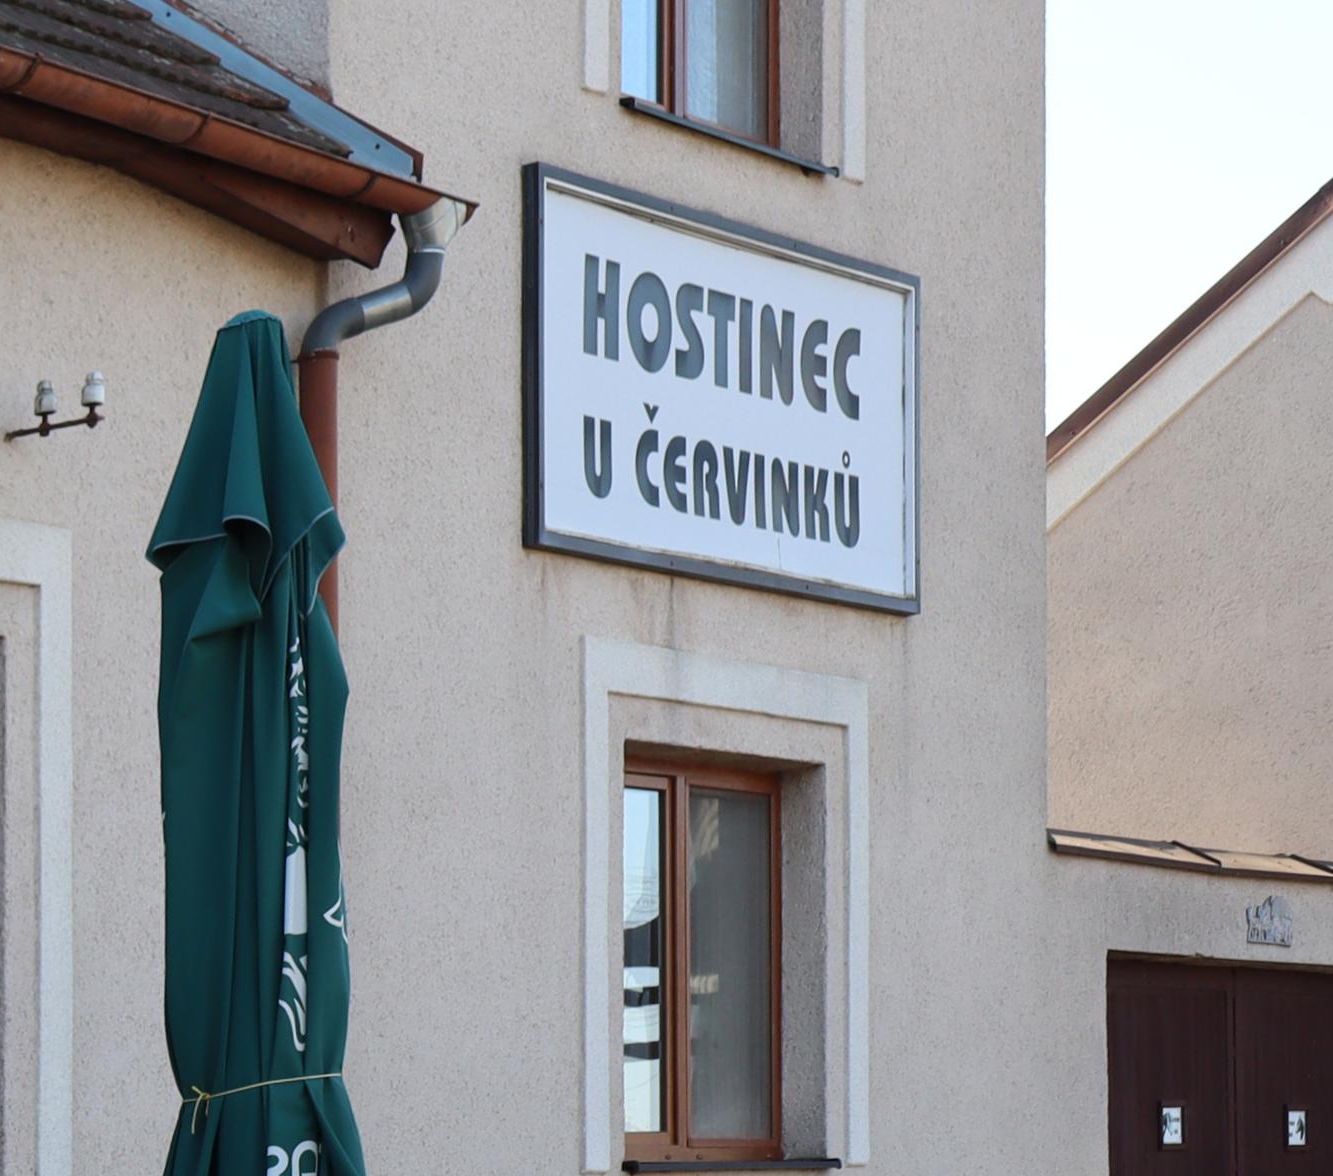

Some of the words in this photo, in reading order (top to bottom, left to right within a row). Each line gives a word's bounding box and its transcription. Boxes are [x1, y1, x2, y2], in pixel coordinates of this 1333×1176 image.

[583, 252, 861, 421] HOSTINEC
[583, 415, 613, 499] U
[635, 402, 861, 549] ČERVINKŮ
